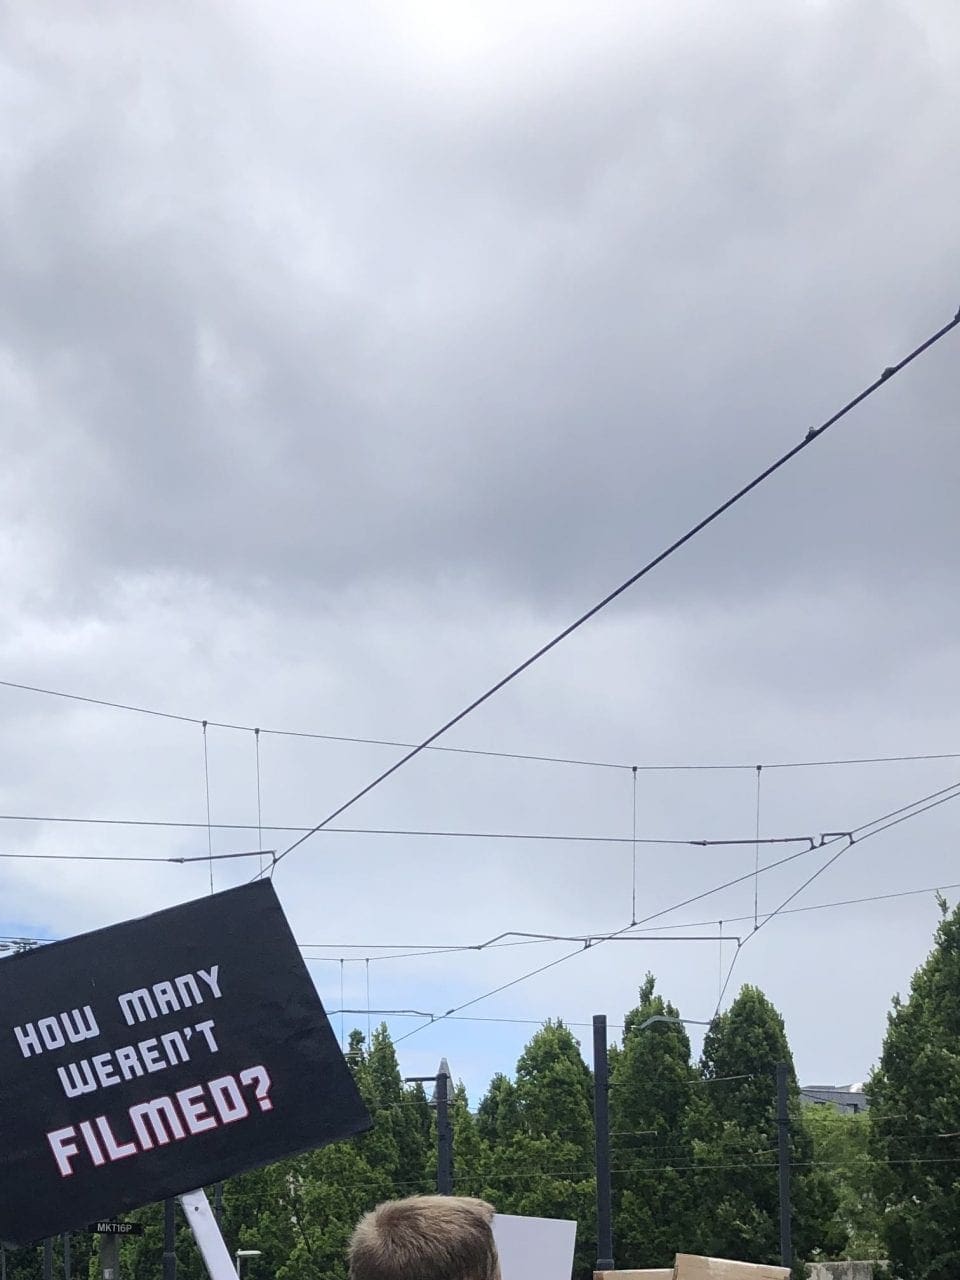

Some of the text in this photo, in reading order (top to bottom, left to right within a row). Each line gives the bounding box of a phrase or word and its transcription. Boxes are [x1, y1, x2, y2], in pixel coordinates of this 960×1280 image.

[13, 965, 224, 1058] HOW MANY
[56, 1020, 220, 1098] WEREN'T
[46, 1065, 274, 1178] FILMED?
[97, 1223, 132, 1233] MKT16P
